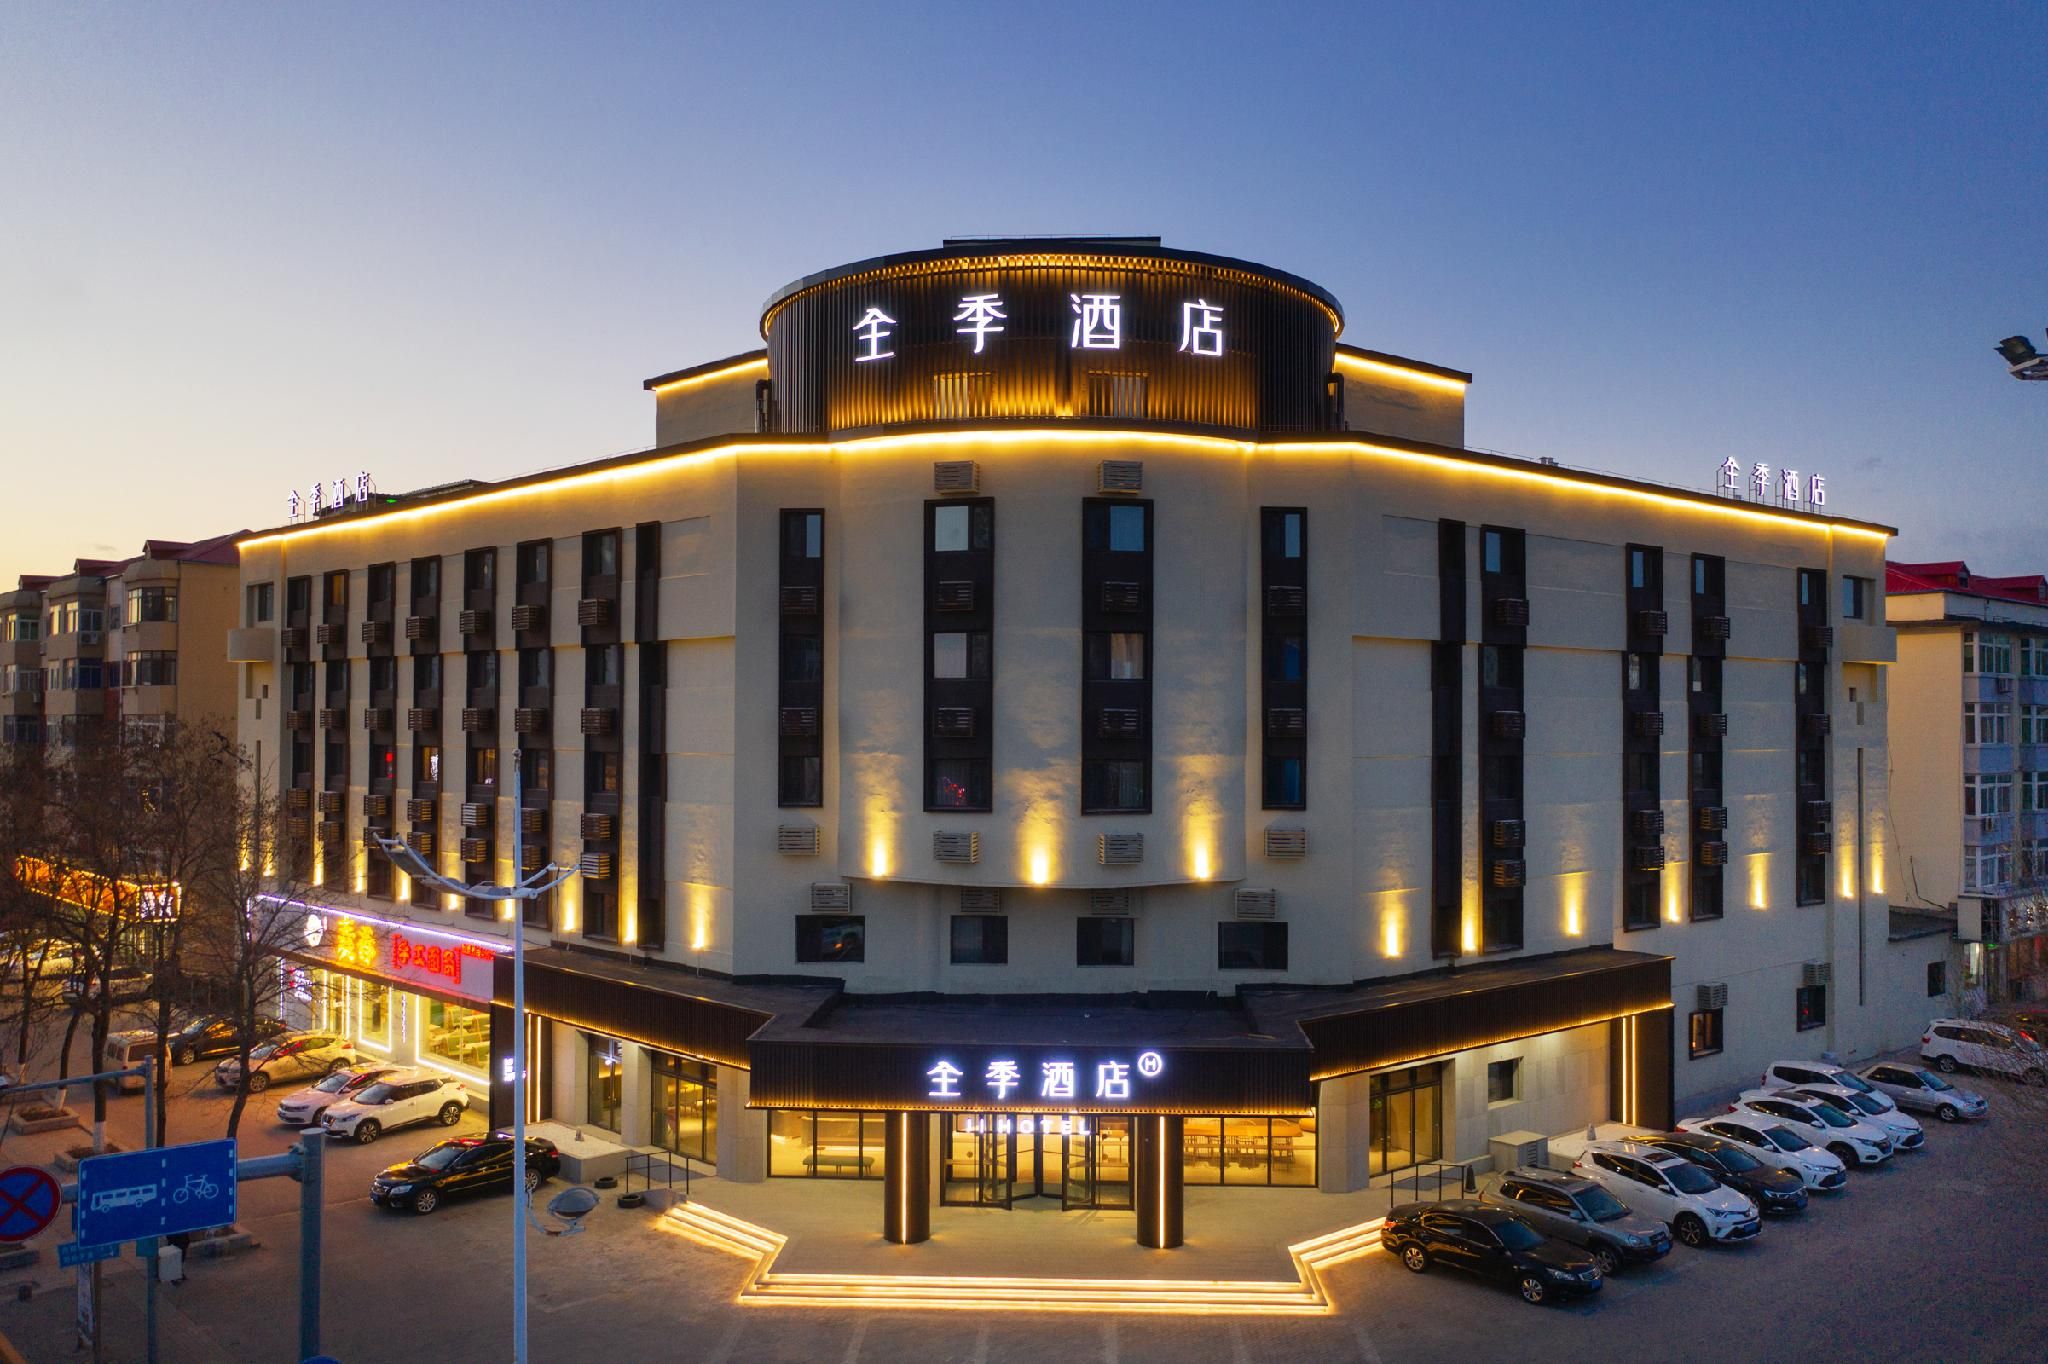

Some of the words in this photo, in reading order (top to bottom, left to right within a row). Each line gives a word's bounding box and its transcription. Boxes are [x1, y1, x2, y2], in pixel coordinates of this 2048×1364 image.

[852, 292, 1224, 362] 全季酒店
[287, 470, 370, 518] 全季酒店
[1722, 456, 1826, 505] 全季酒店
[926, 1060, 1130, 1099] 全季酒店
[998, 1118, 1091, 1135] HOTEL
